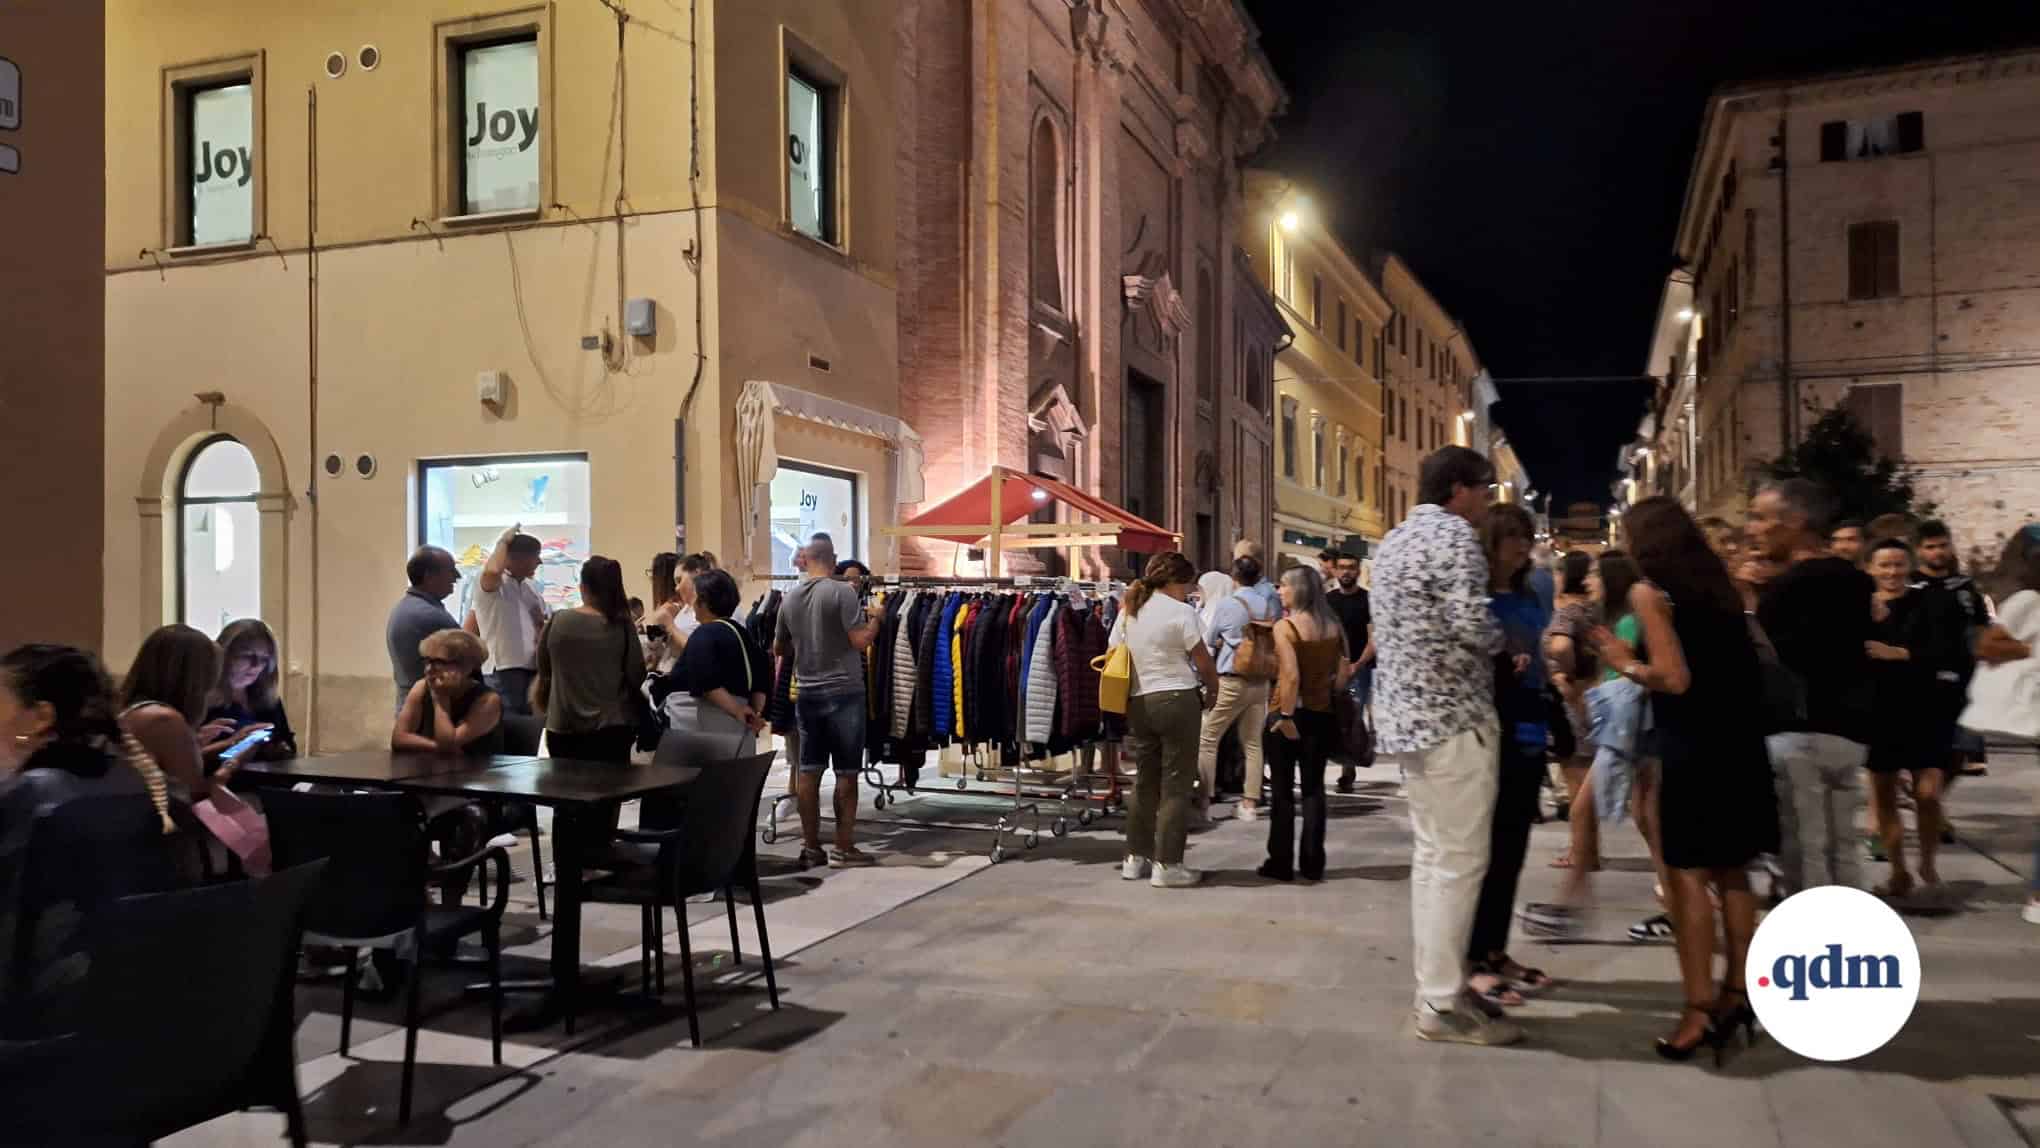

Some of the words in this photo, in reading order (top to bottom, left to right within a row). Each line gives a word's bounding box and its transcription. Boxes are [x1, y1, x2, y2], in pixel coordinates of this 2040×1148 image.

[468, 102, 538, 152] Joy
[196, 140, 252, 187] Joy
[800, 488, 818, 511] Joy
